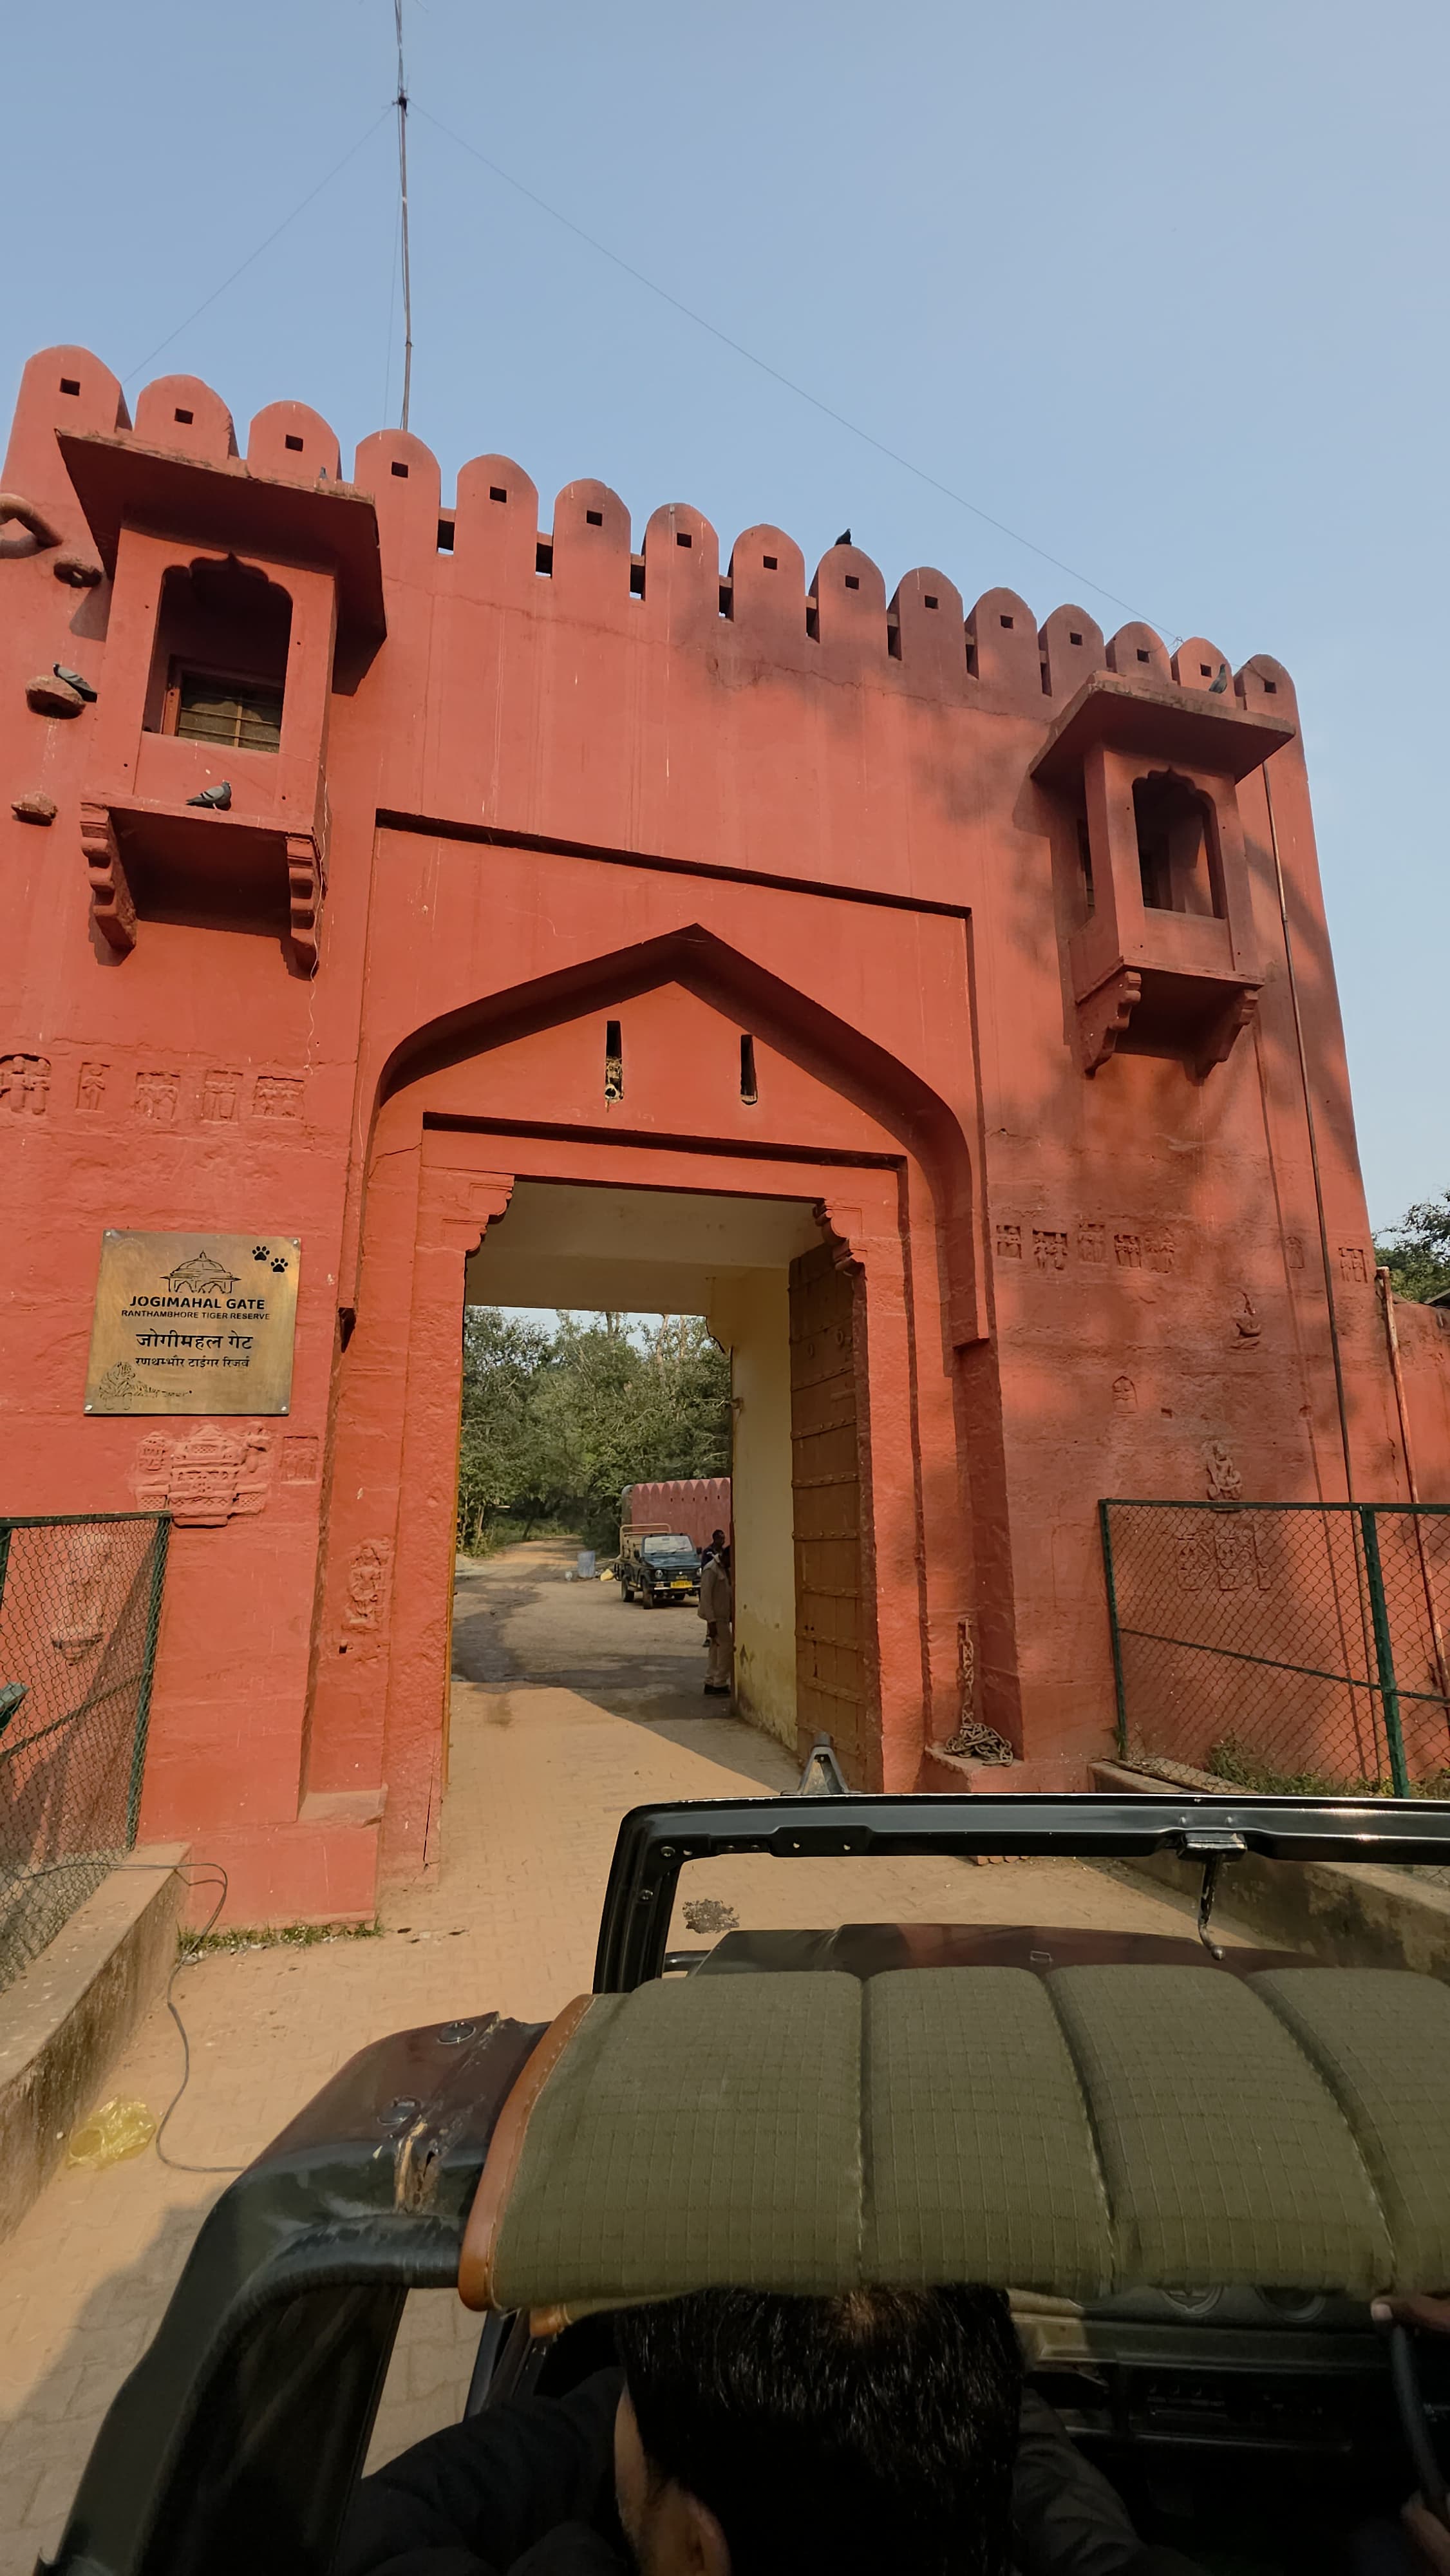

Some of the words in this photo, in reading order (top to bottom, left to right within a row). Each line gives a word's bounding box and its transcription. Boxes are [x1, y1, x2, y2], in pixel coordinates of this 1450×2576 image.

[129, 1296, 221, 1309] JOGIMAHAL
[227, 1298, 265, 1309] GATE
[121, 1310, 199, 1318] RANTHAMBHORE
[136, 1328, 223, 1350] जोगीमहल
[228, 1330, 254, 1349] गेट
